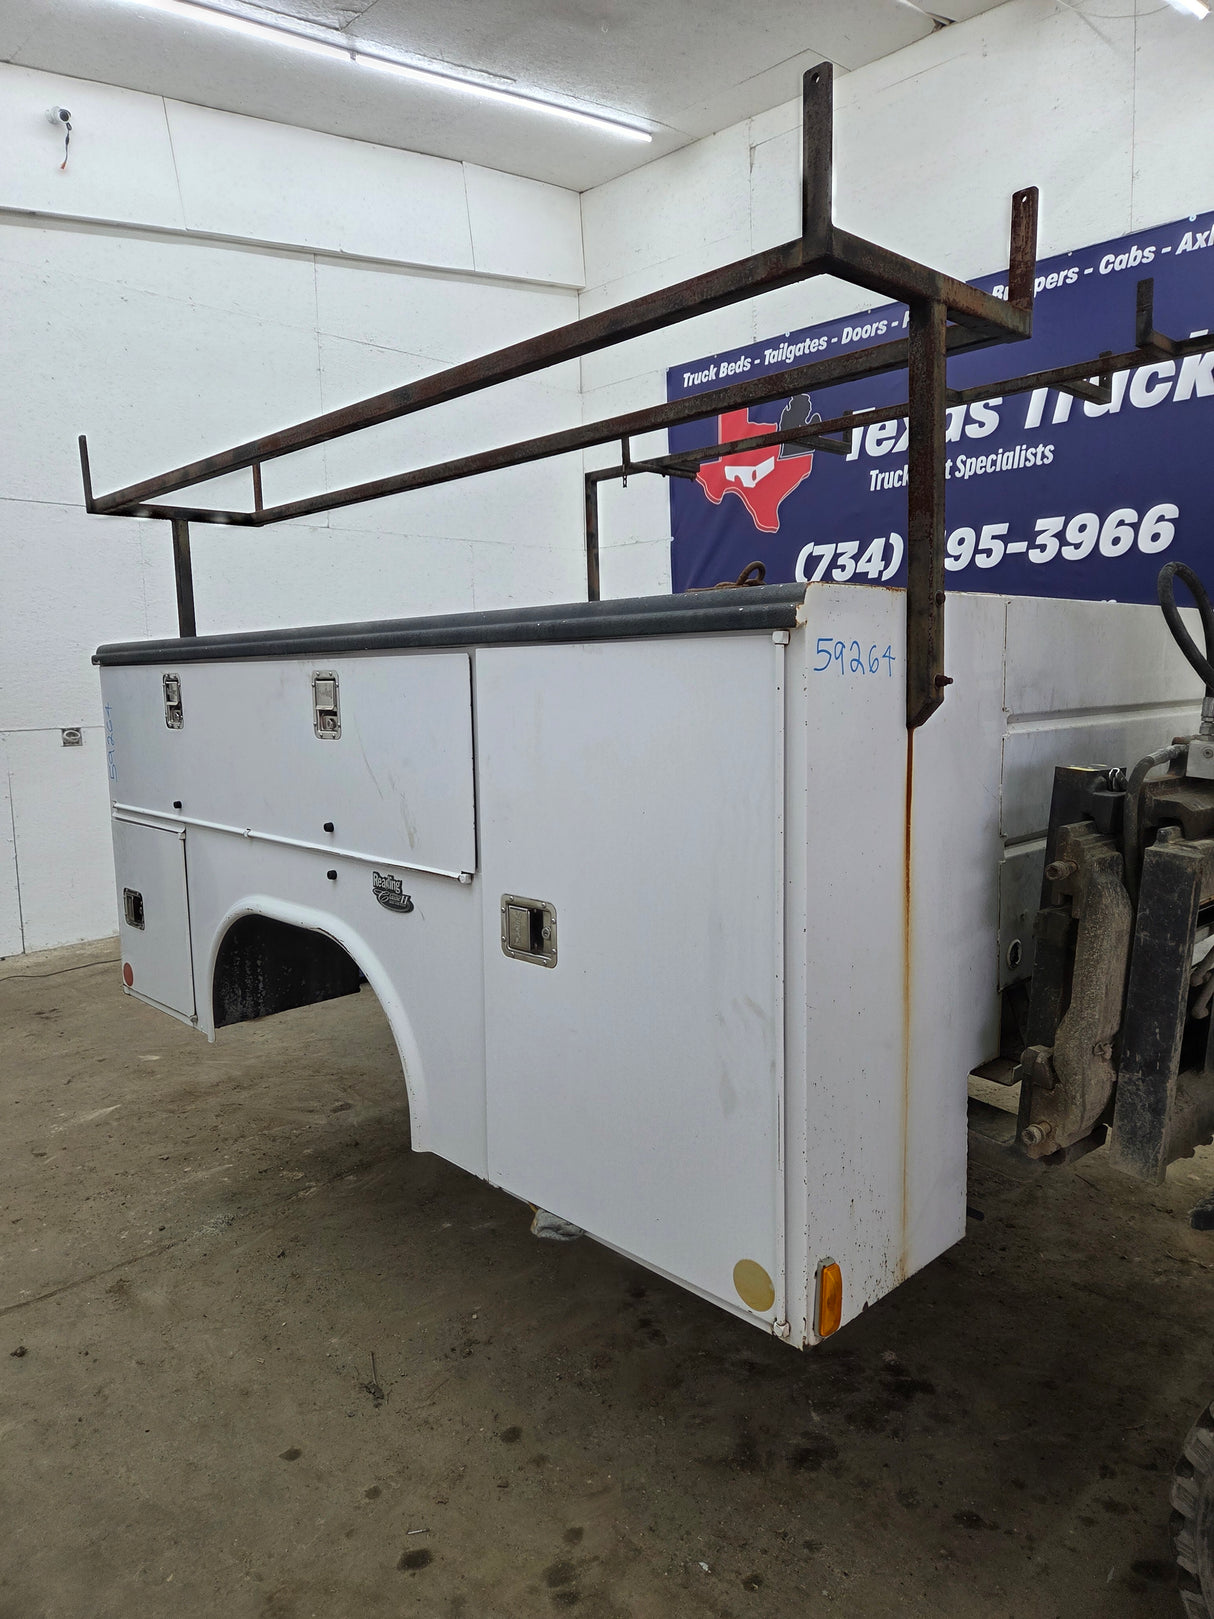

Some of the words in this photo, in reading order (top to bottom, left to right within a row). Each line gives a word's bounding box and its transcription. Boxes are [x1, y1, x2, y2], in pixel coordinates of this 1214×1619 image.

[683, 365, 717, 387] Truck
[719, 356, 751, 378] Beds
[763, 336, 828, 366] Tailgates
[841, 321, 887, 344] Doors
[992, 266, 1079, 300] Bpers
[1099, 245, 1156, 275] Cabs
[955, 444, 1055, 480] Specialists
[795, 532, 904, 582] (734)
[944, 503, 1180, 572] 95-3966
[813, 638, 896, 677] 59264
[373, 871, 402, 894] Reading
